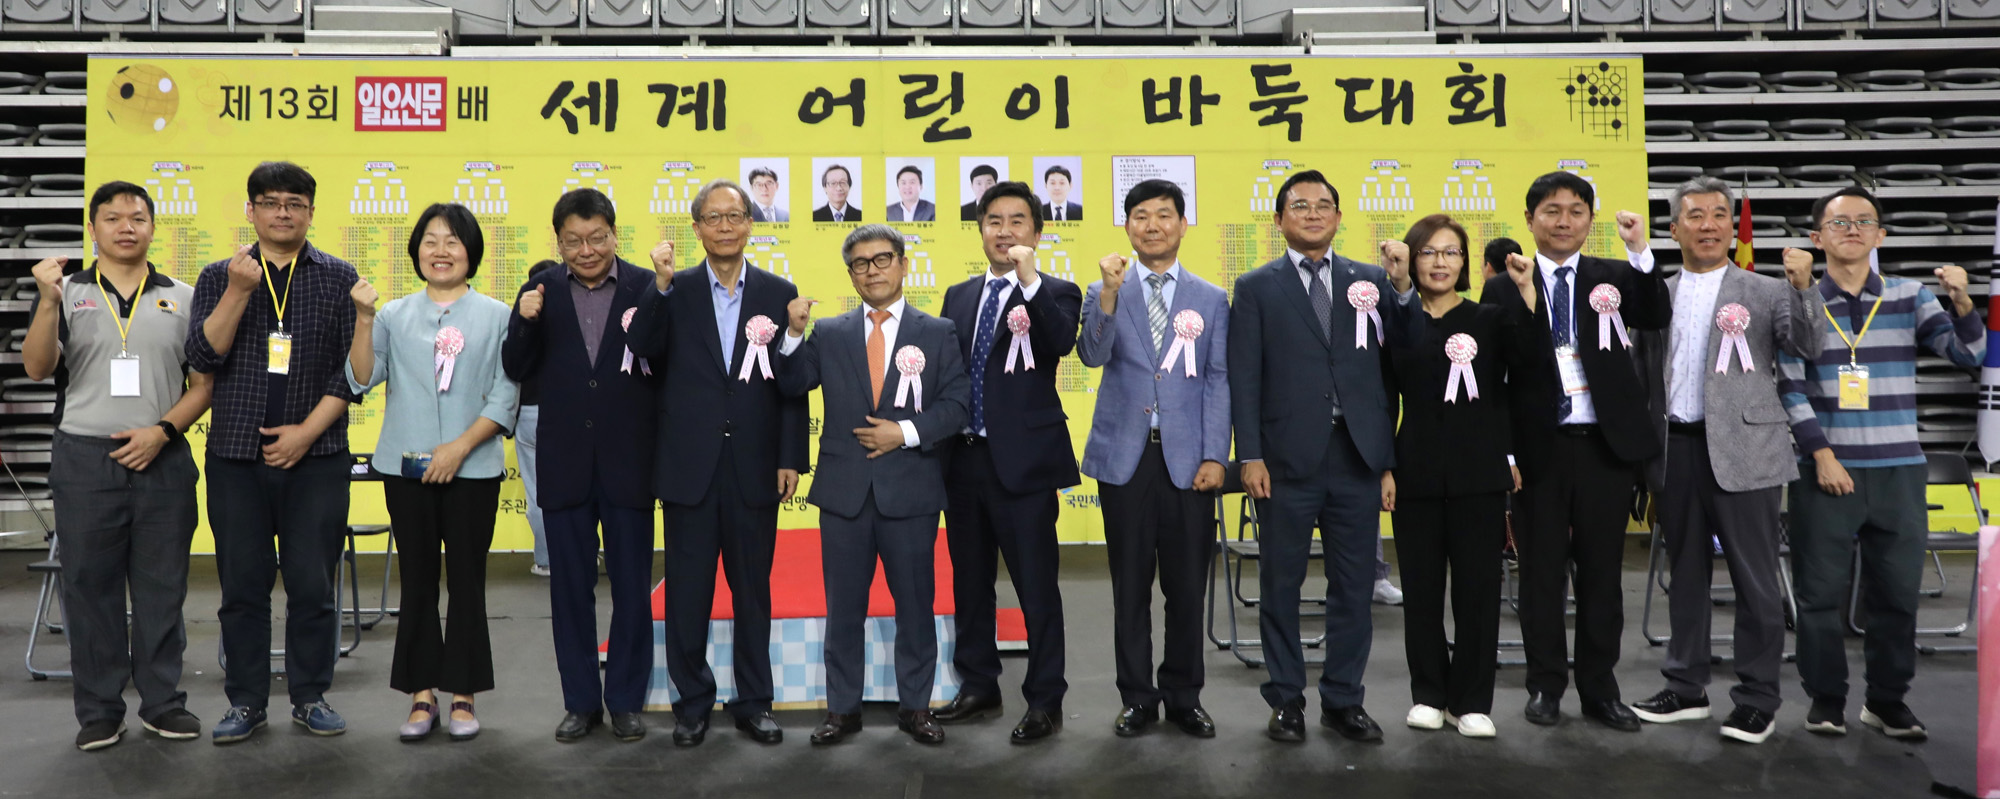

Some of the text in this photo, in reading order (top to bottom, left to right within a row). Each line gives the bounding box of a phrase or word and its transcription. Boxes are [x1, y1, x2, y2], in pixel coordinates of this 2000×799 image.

[219, 61, 1508, 143] 제13회 일요신문 배 세계 어린이 바둑대회
